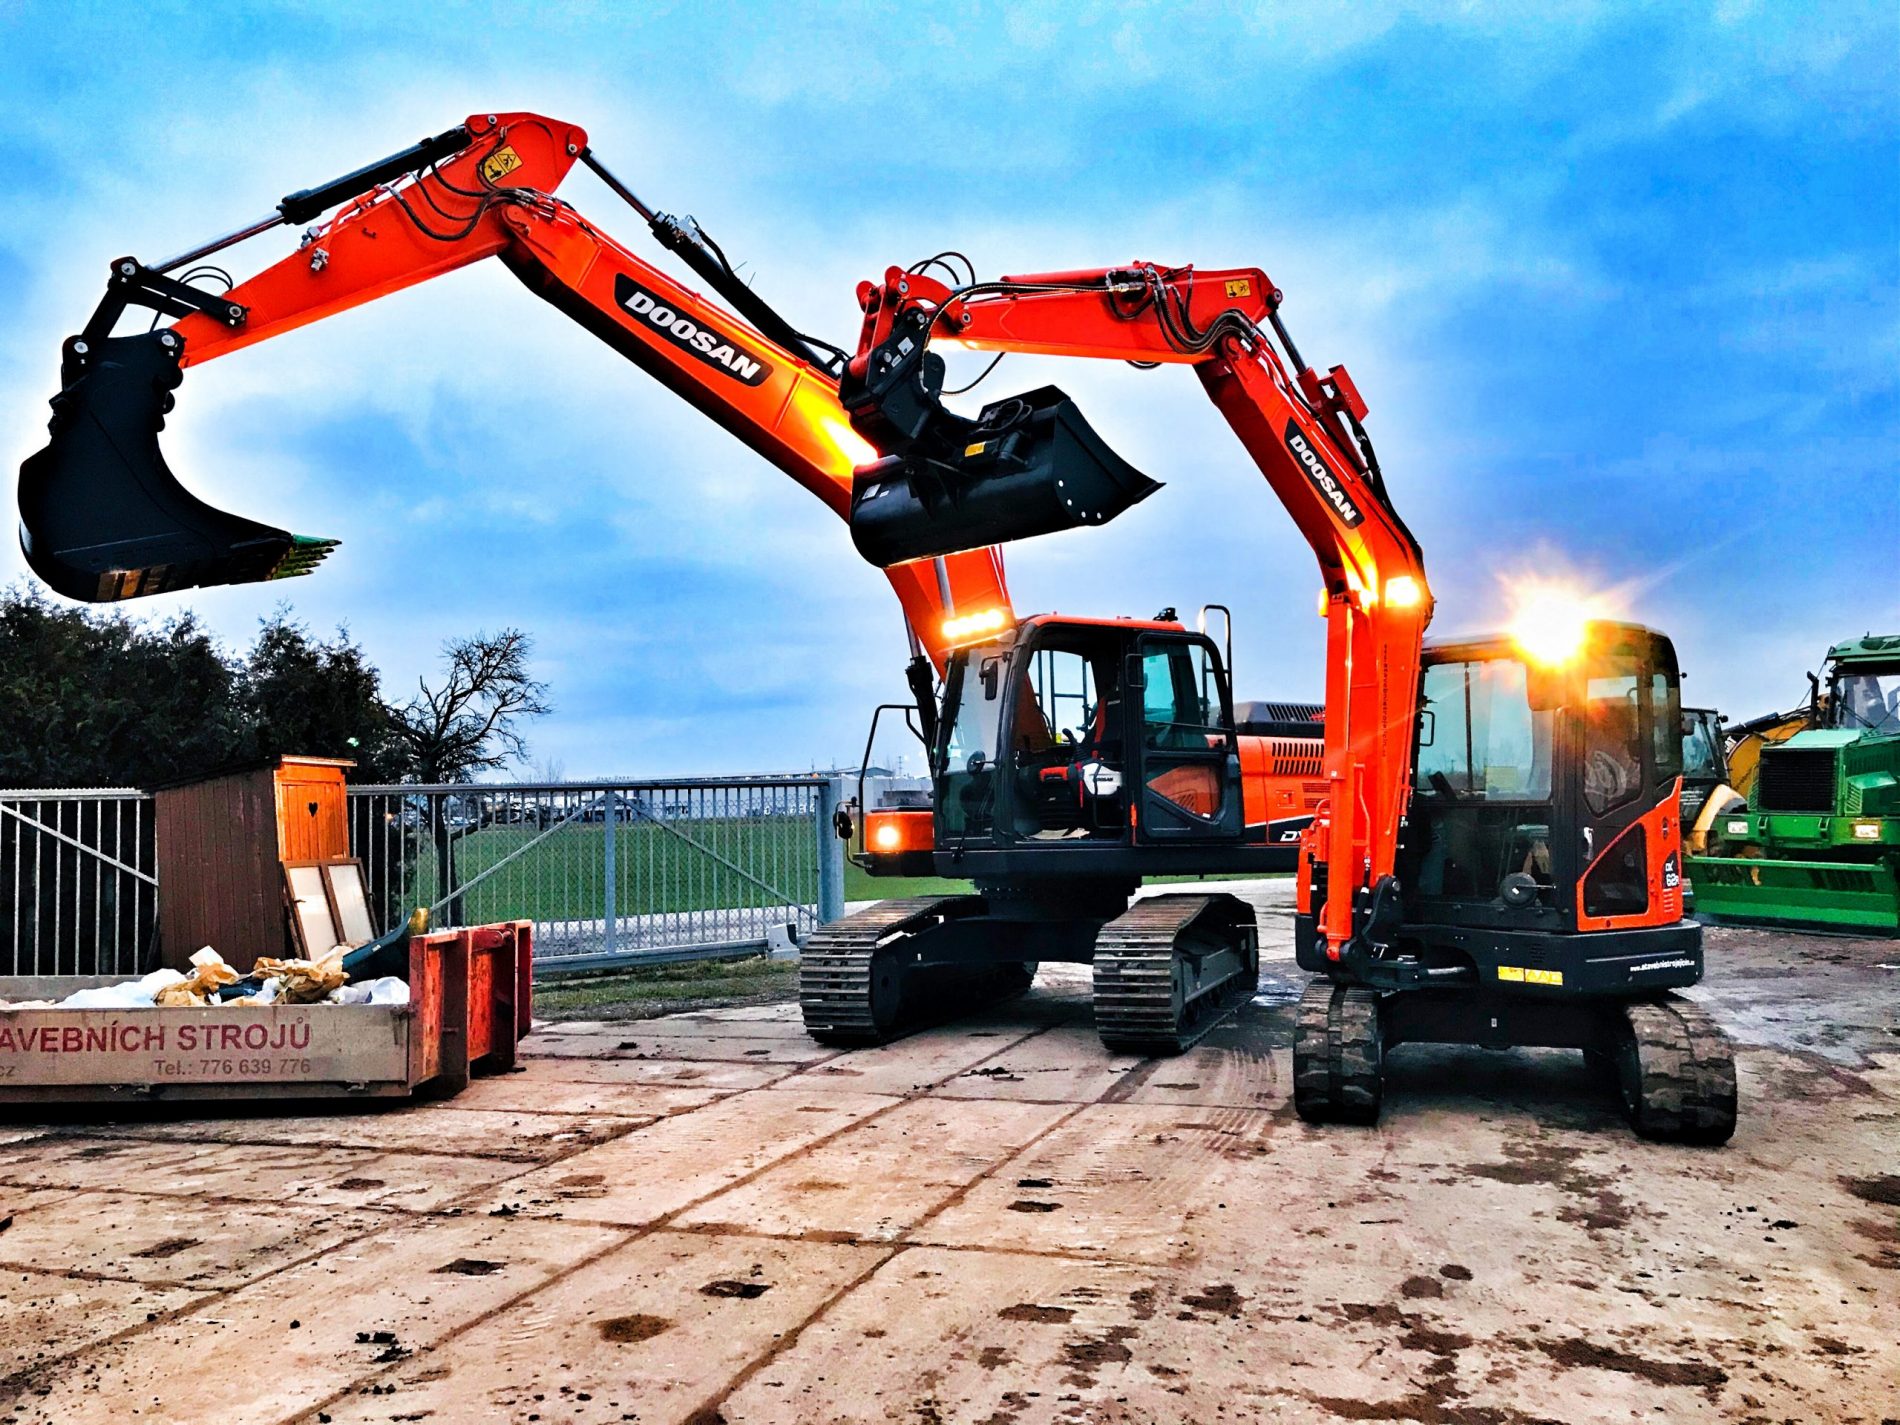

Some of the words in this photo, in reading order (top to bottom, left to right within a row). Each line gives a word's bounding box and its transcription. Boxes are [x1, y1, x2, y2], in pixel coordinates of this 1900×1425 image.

[624, 291, 761, 380] DOOSAN
[1289, 434, 1357, 521] DOOSAN
[0, 1020, 165, 1053] AVEBNÍCH
[177, 1016, 310, 1051] STROJŮ
[154, 1060, 193, 1075] Tel.:
[200, 1059, 233, 1074] 776
[239, 1059, 272, 1074] 639
[279, 1059, 311, 1074] 776
